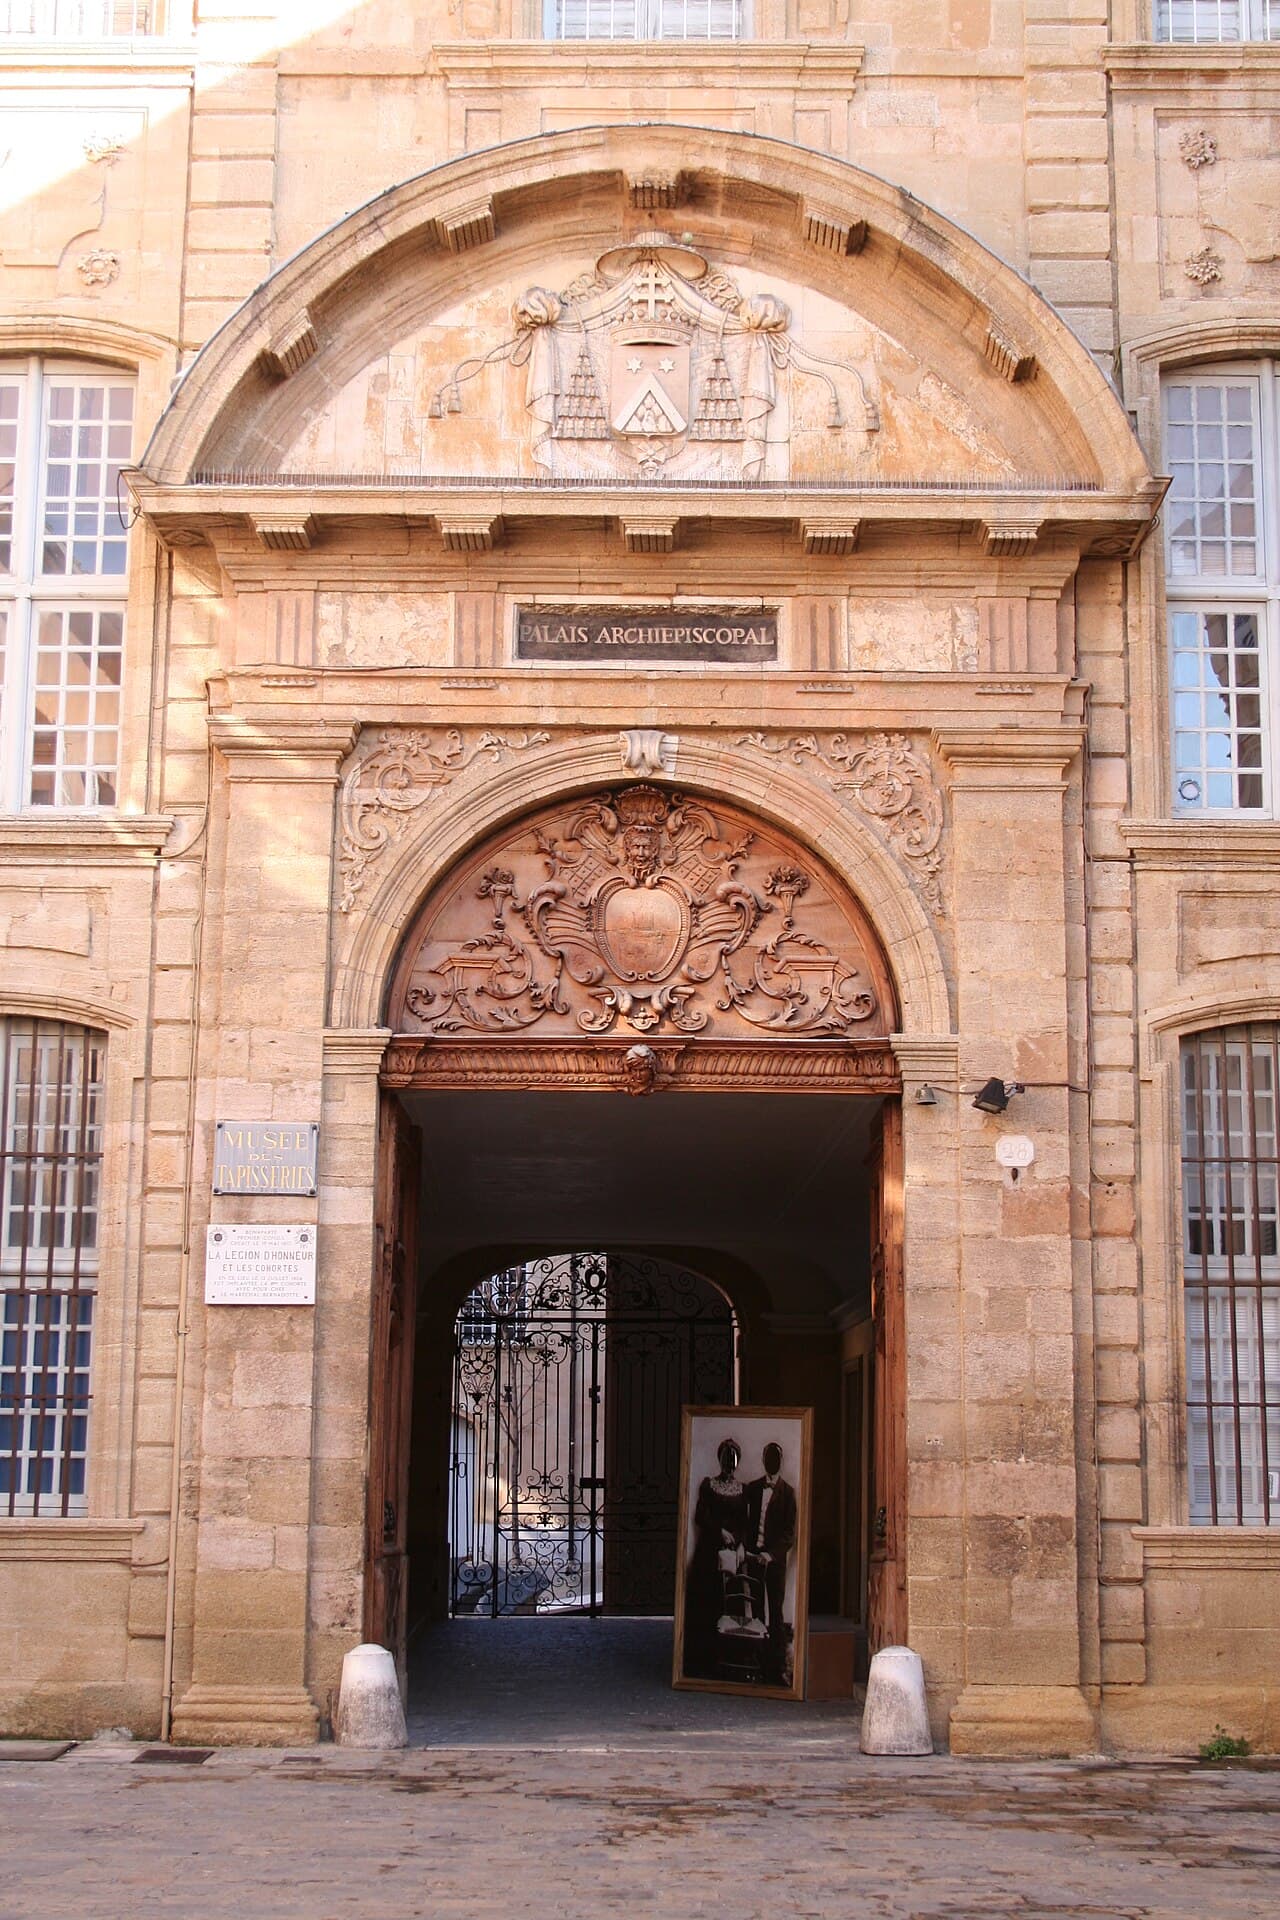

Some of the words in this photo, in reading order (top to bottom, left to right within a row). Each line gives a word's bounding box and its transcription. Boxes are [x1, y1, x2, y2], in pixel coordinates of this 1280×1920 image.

[519, 623, 588, 644] PALAIS
[594, 626, 775, 645] ARCHIEPISCOPAL
[223, 1131, 309, 1150] MUSEE
[249, 1153, 284, 1161] DES
[216, 1165, 314, 1189] TAPISSERIES
[208, 1250, 221, 1260] LA
[222, 1263, 233, 1272] ET
[236, 1263, 252, 1272] LES
[255, 1264, 298, 1273] COHORTES
